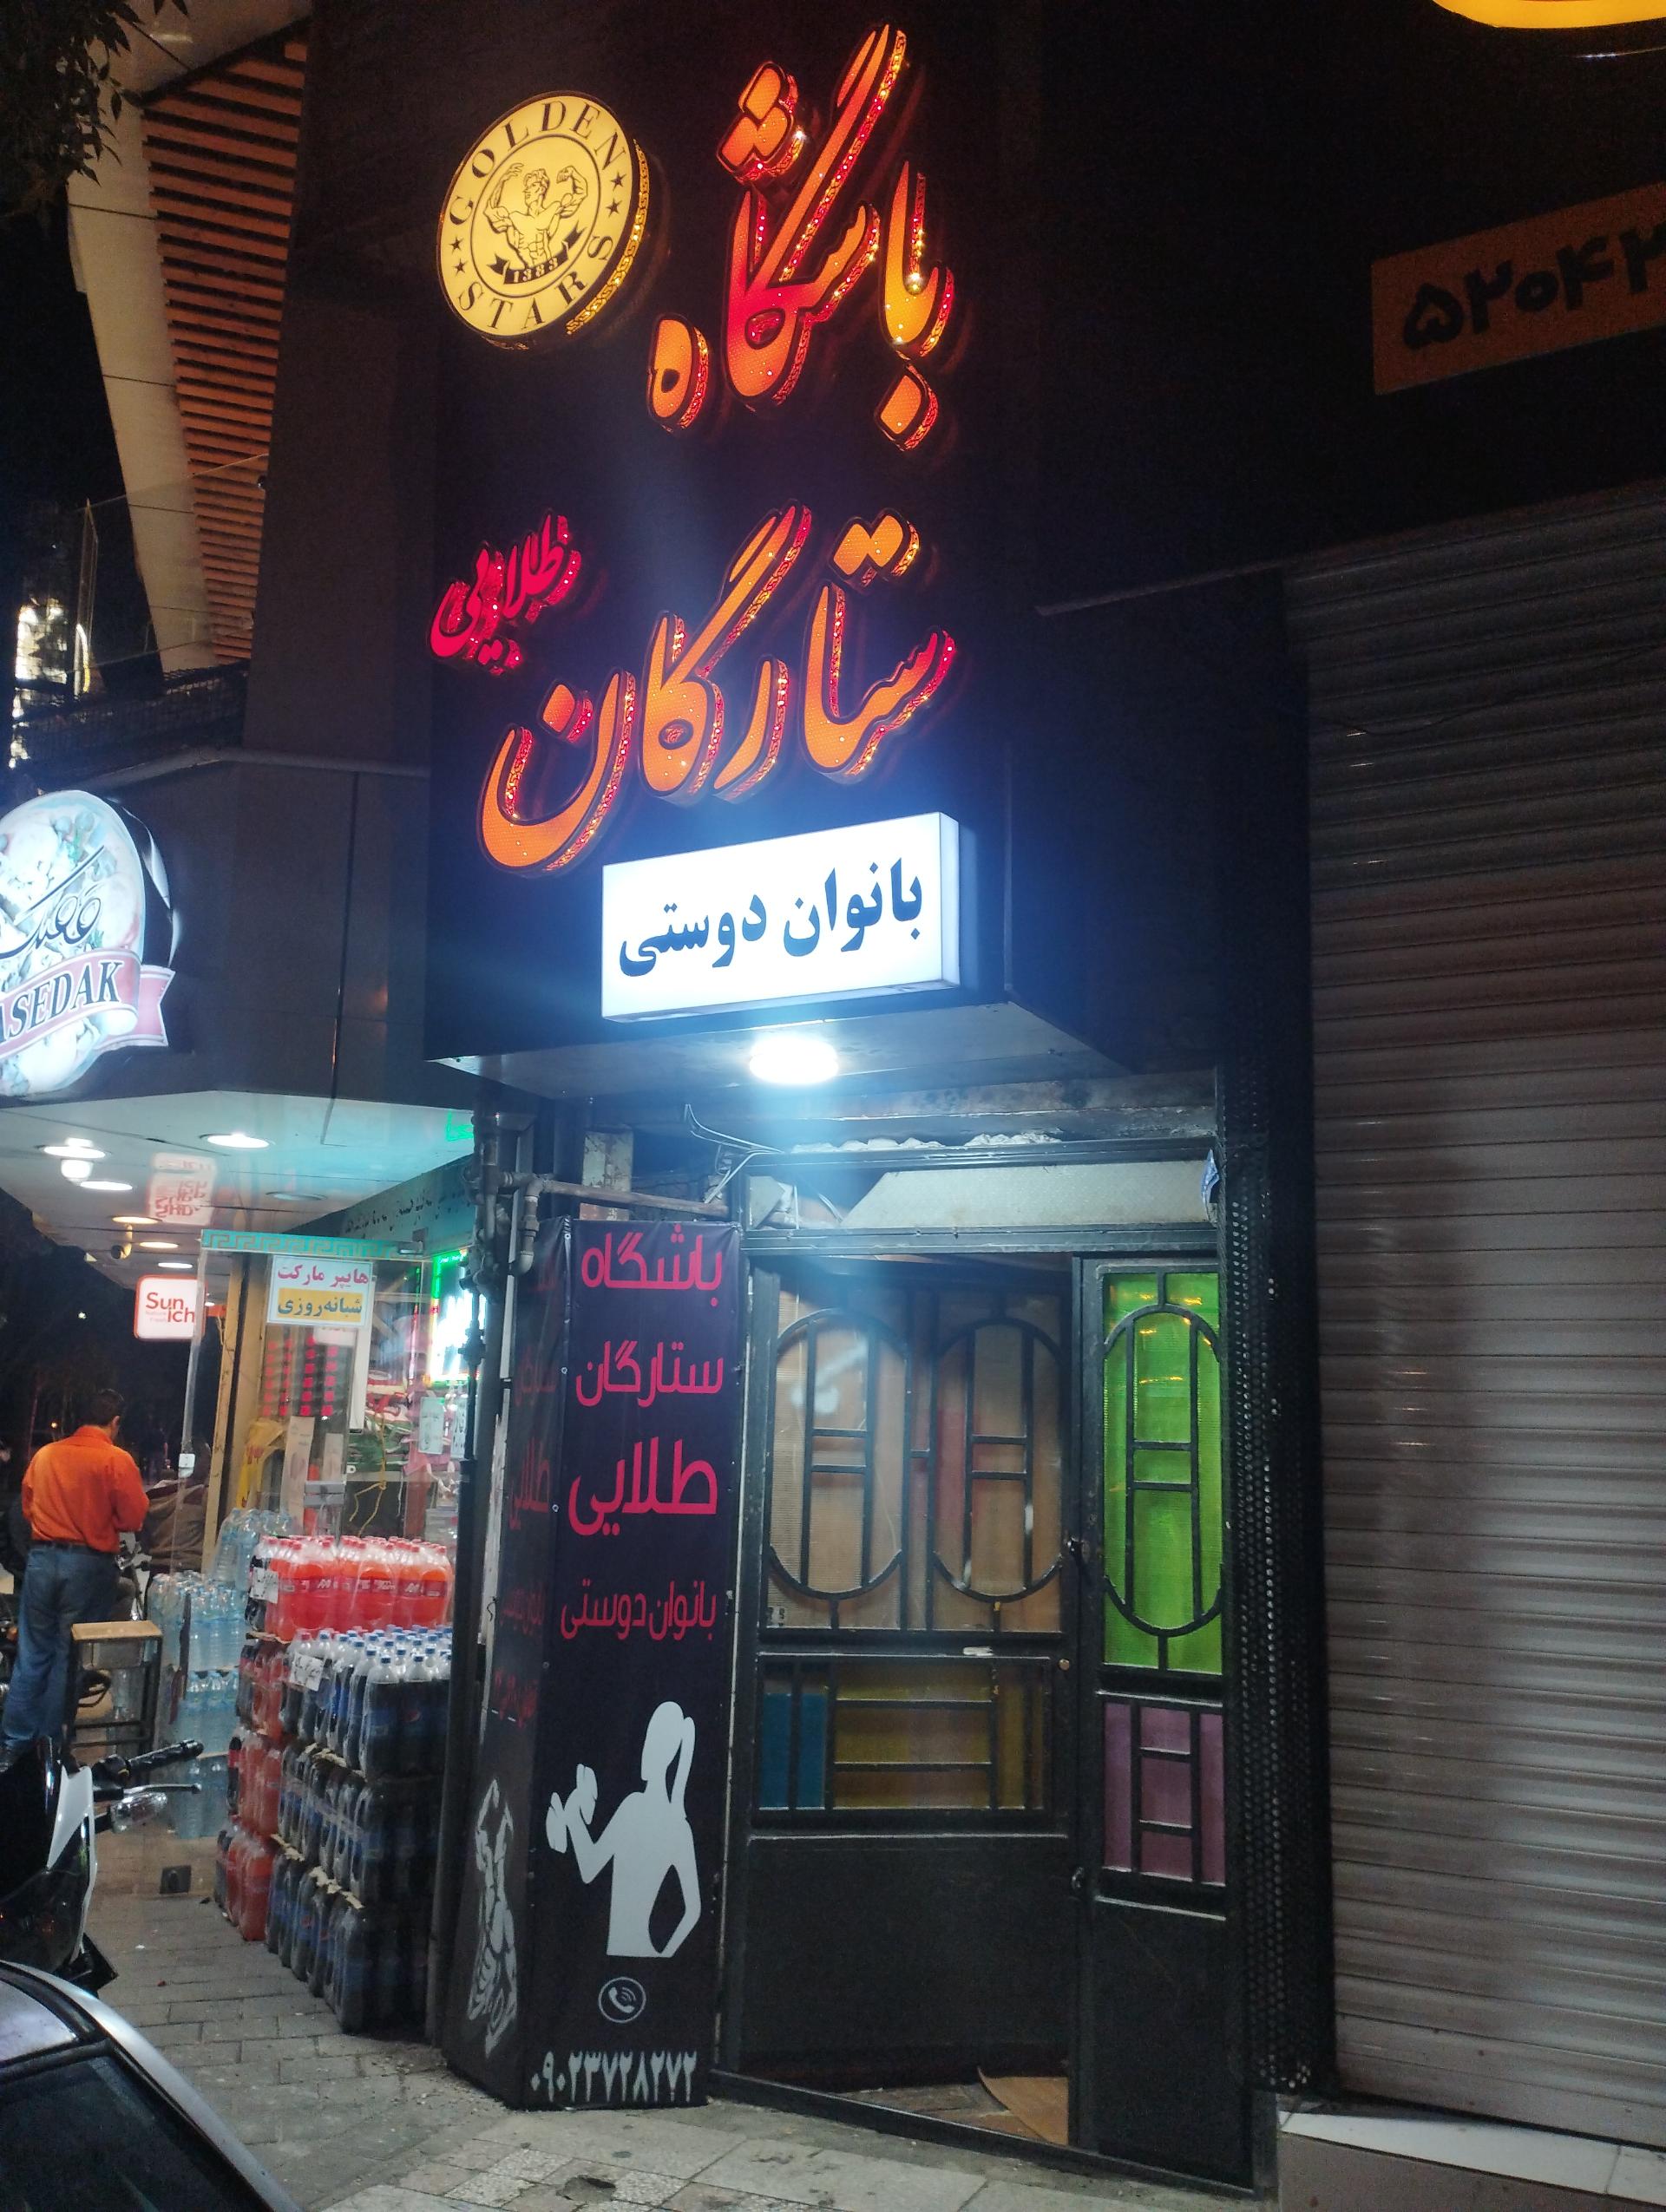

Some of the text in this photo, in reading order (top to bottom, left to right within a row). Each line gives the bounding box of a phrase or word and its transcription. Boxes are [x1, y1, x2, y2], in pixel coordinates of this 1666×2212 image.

[449, 99, 627, 226] GOLDEN
[457, 235, 614, 330] STARS
[646, 22, 950, 449] باشگاه
[430, 509, 583, 673] طلایی
[477, 503, 957, 873] ستارگان
[618, 856, 923, 978] بانوان دوستی
[145, 1292, 184, 1310] Sun
[278, 1264, 369, 1288] هایپر مارکت
[580, 1222, 723, 1306] باشگاه
[575, 1340, 725, 1407] ستارگان
[568, 1436, 718, 1535] طلایی
